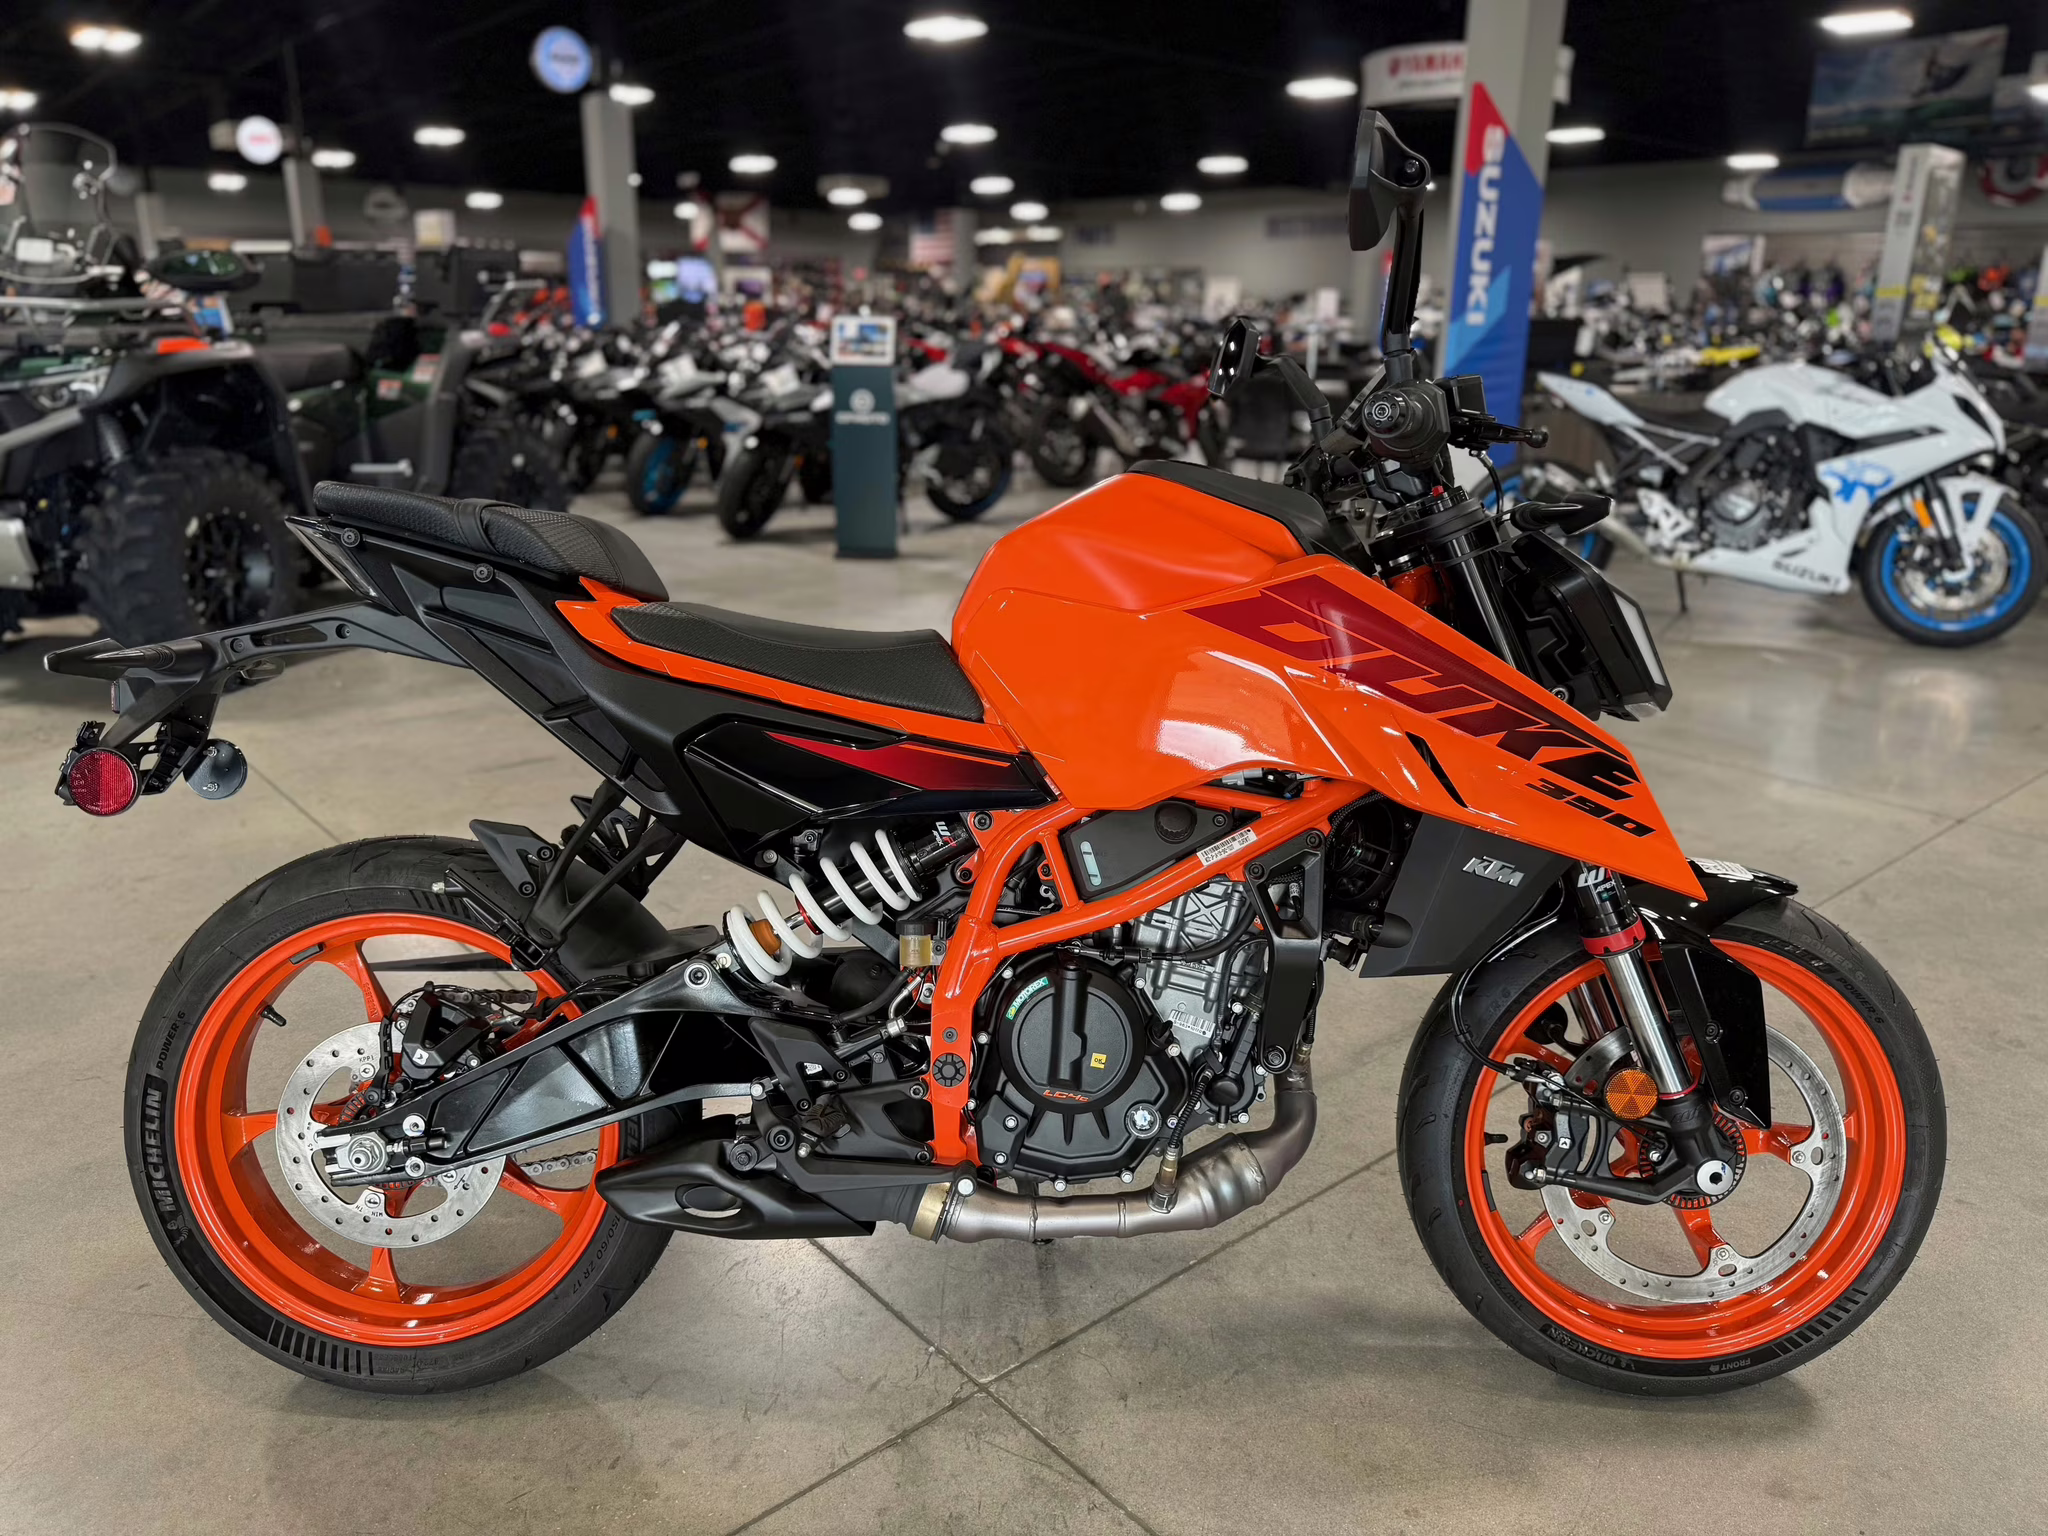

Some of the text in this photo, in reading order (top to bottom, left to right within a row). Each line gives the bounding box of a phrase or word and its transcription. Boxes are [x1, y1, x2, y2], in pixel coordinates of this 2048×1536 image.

[1466, 124, 1505, 326] SUZUKI
[1183, 587, 1642, 802] DUKE
[1525, 777, 1656, 838] 390
[1463, 856, 1525, 887] KTM
[1802, 934, 1853, 974] POWER
[1013, 978, 1046, 1009] MOTOREX
[1836, 977, 1885, 1024] POWER 6
[156, 1010, 187, 1071] POWER 6
[144, 1087, 176, 1213] MICHELIN
[572, 1215, 620, 1294] 150/60 ZR 17
[1546, 1326, 1616, 1366] MICHELIN
[1720, 1357, 1751, 1369] FRONT
